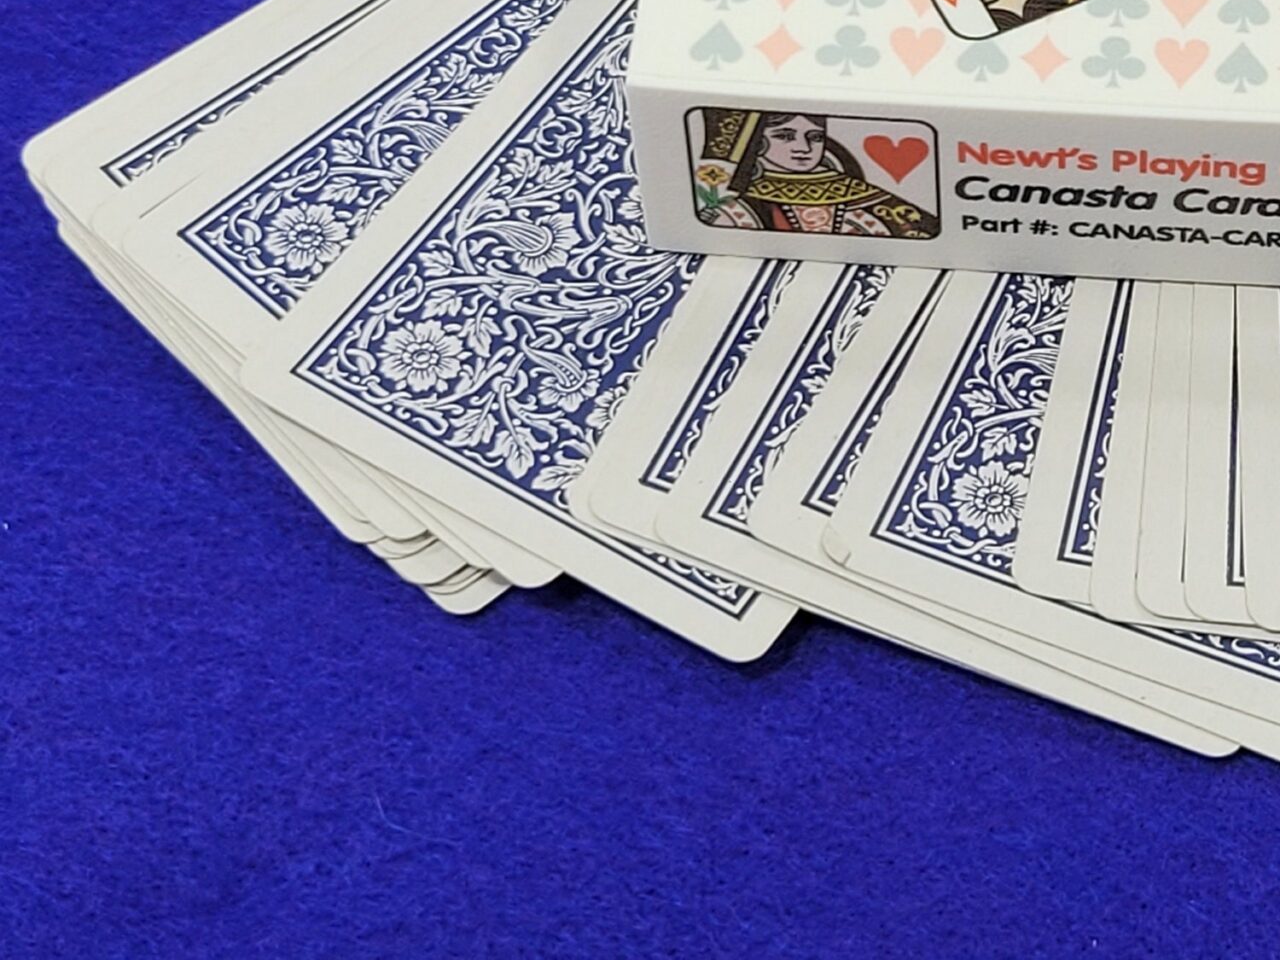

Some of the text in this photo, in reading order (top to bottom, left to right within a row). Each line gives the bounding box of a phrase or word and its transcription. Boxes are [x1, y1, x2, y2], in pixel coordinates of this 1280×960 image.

[957, 141, 1098, 172] Newt's
[1112, 150, 1267, 185] Playing
[954, 175, 1156, 212] Canasta
[962, 214, 1021, 235] Part
[1027, 217, 1059, 238] #:
